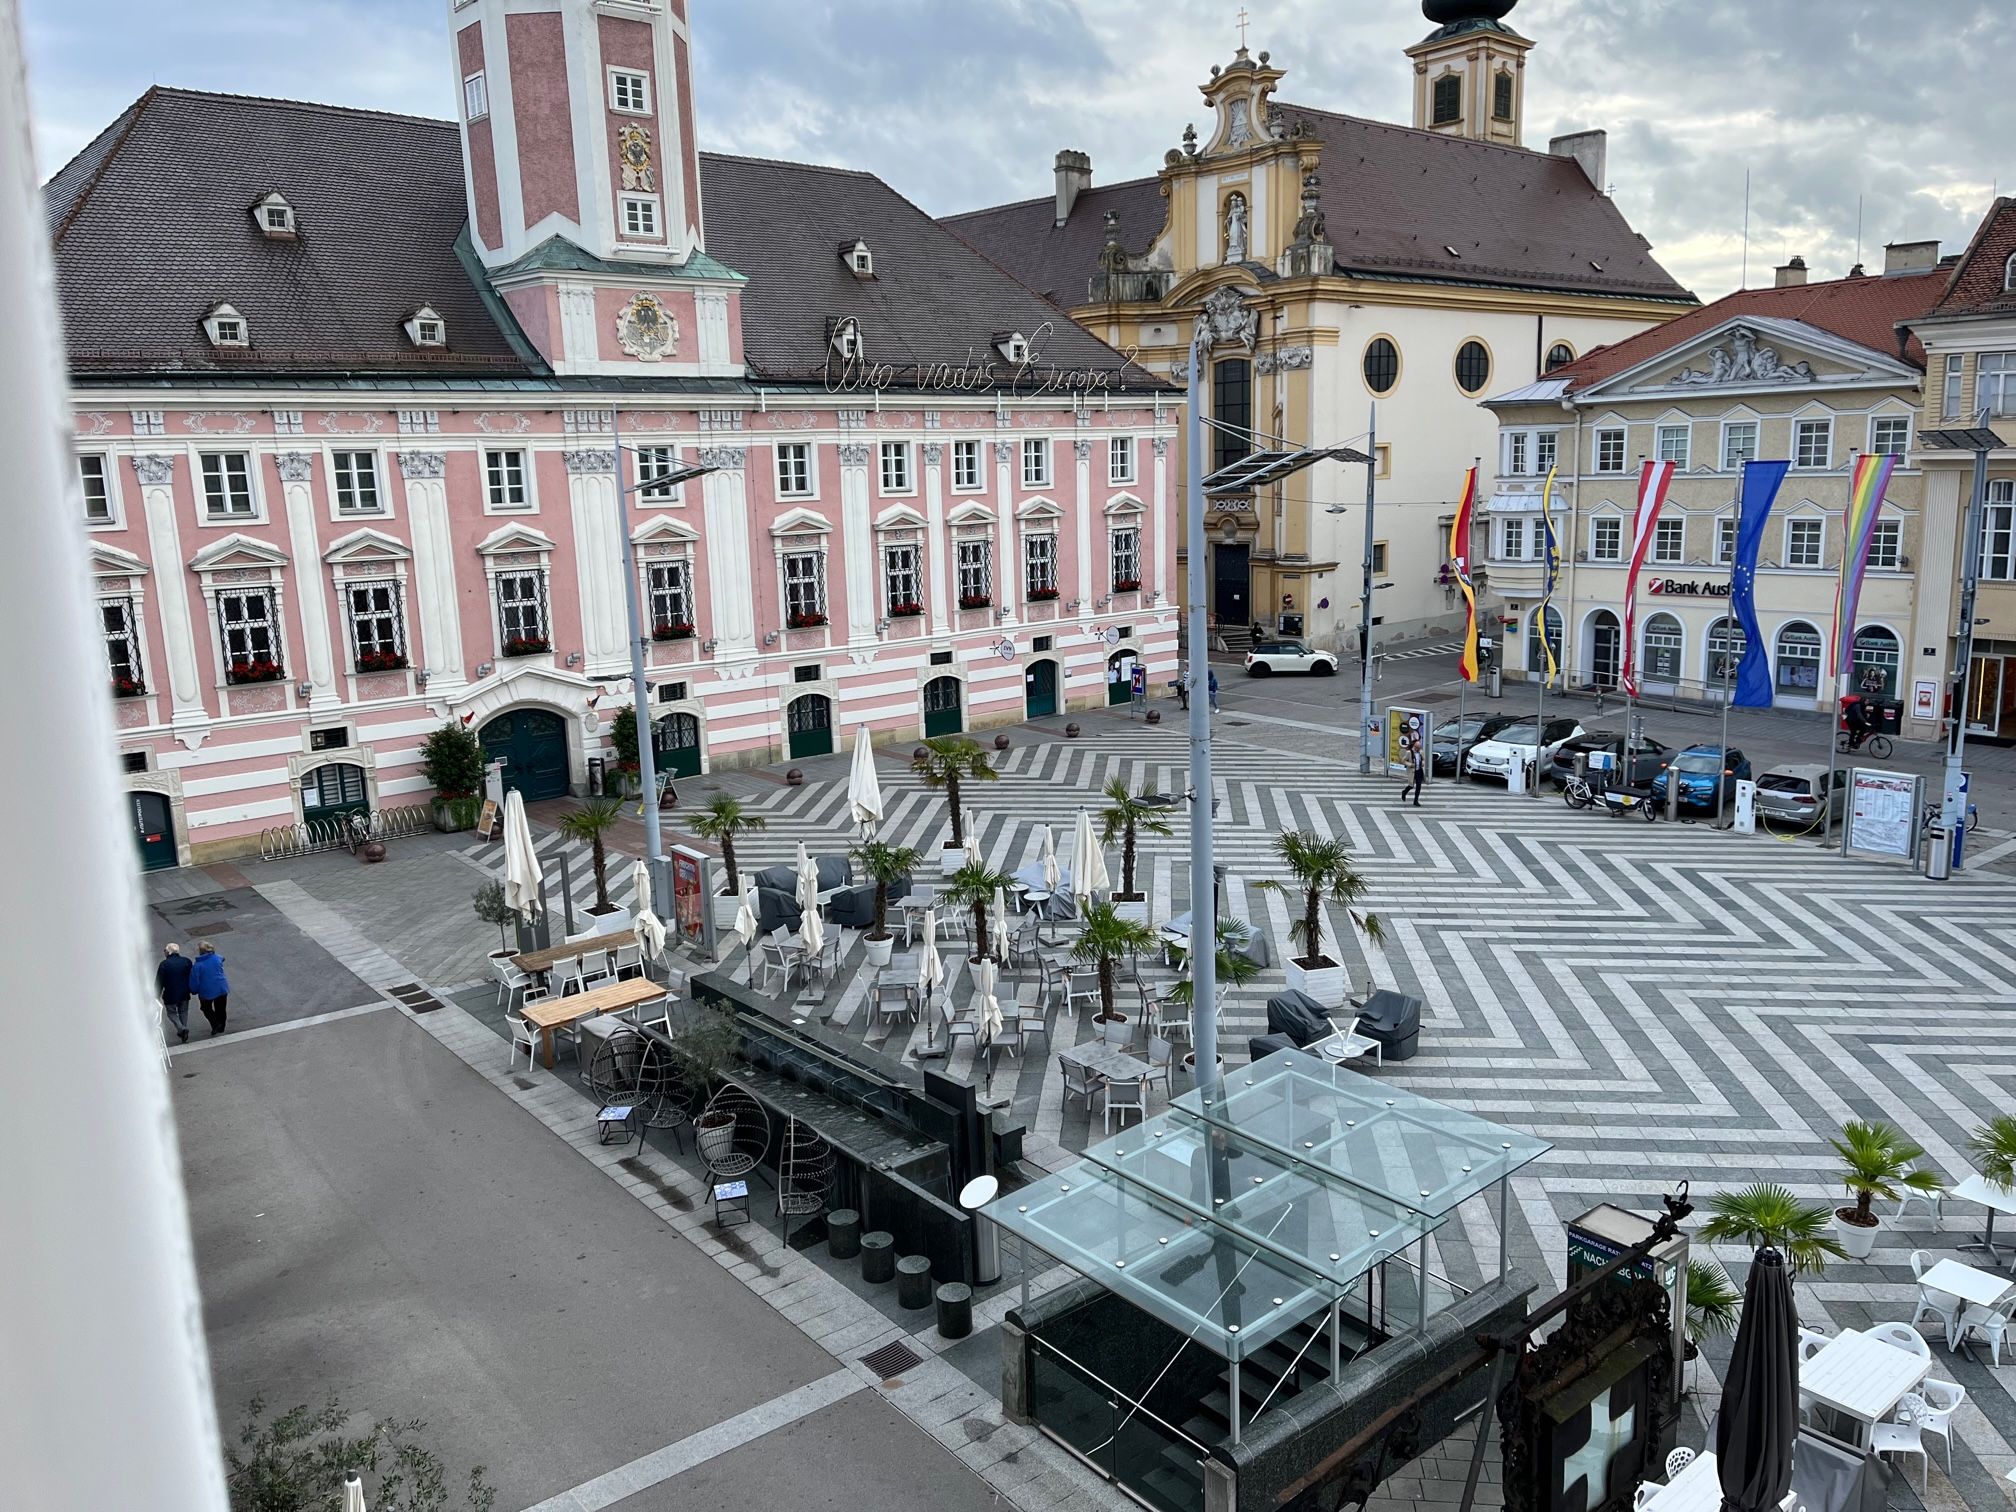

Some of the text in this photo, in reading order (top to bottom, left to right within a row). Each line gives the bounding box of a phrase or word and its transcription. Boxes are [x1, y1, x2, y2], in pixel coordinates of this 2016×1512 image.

[825, 316, 893, 393] Quo
[917, 346, 998, 393] vadis
[1664, 578, 1699, 595] Bank
[1568, 1231, 1607, 1252] PARKGARAGE
[1665, 1266, 1677, 1282] WC
